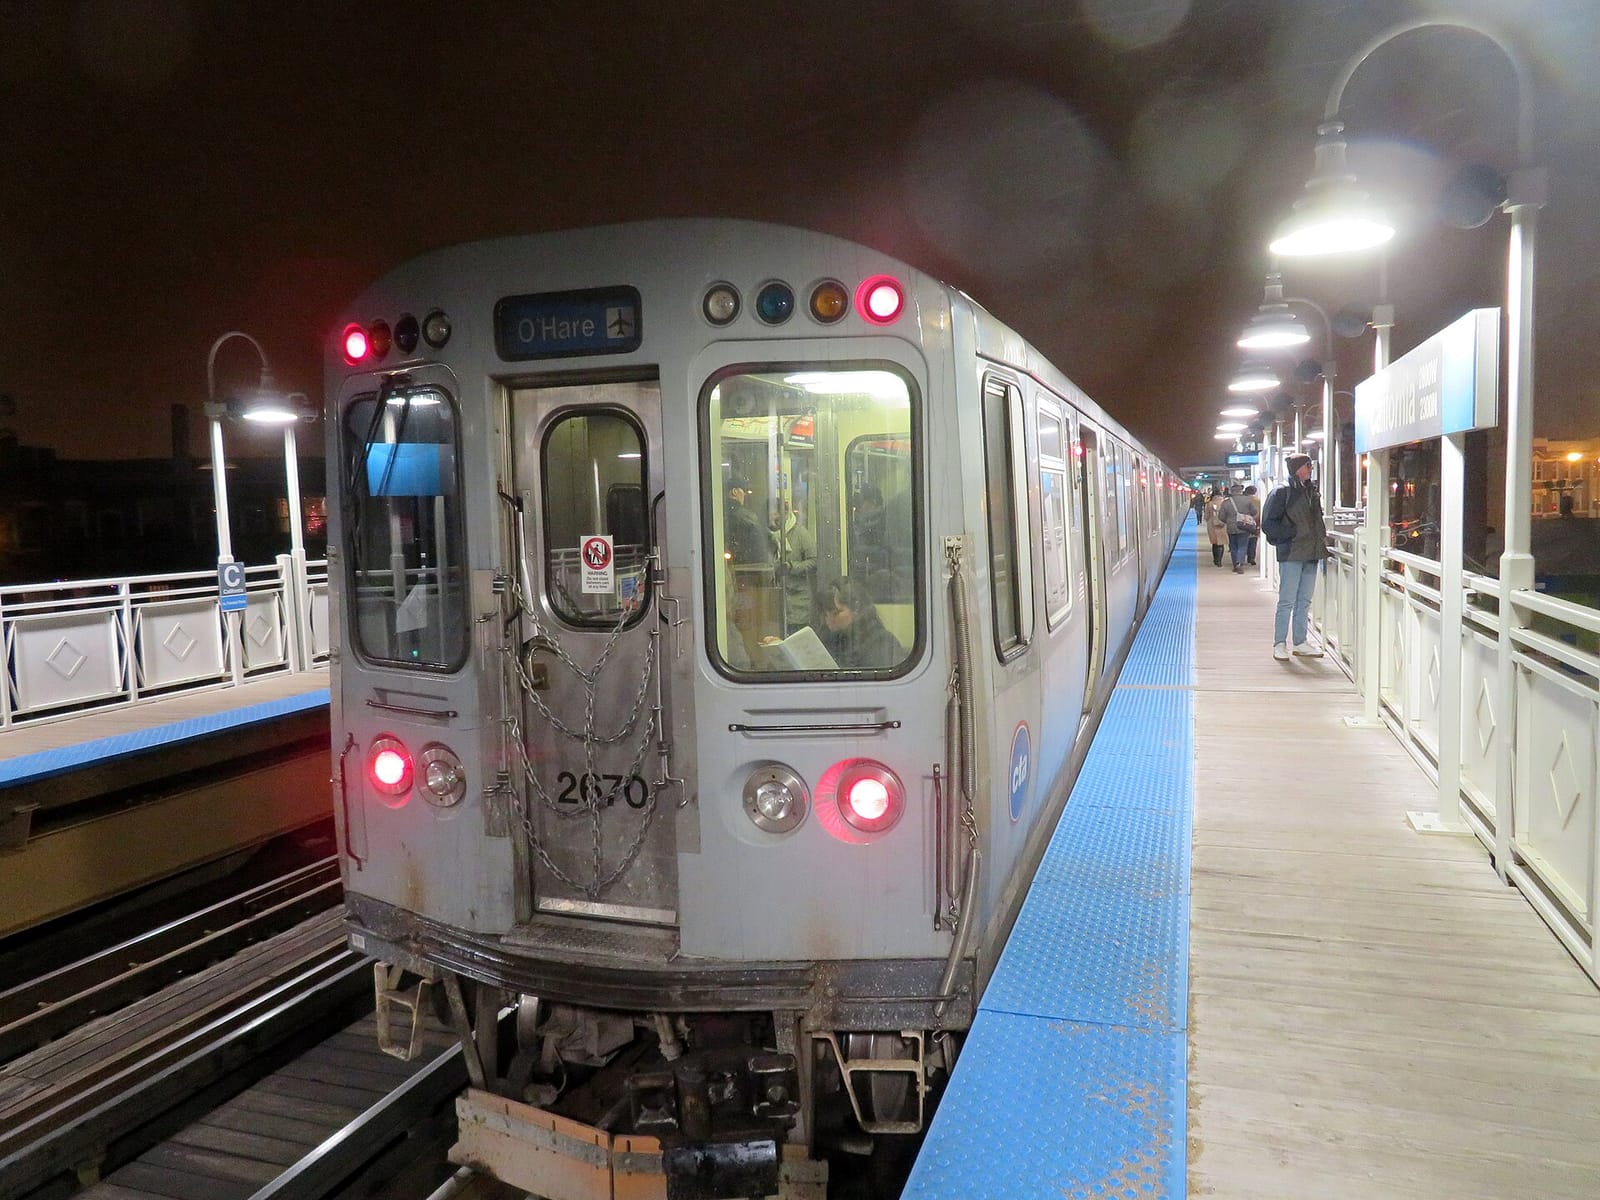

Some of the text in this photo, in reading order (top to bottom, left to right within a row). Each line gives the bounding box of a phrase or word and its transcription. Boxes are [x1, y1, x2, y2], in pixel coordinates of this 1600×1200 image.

[518, 314, 595, 343] O'Hare
[224, 565, 241, 588] C
[557, 771, 649, 809] 2670
[1012, 754, 1028, 794] cta
